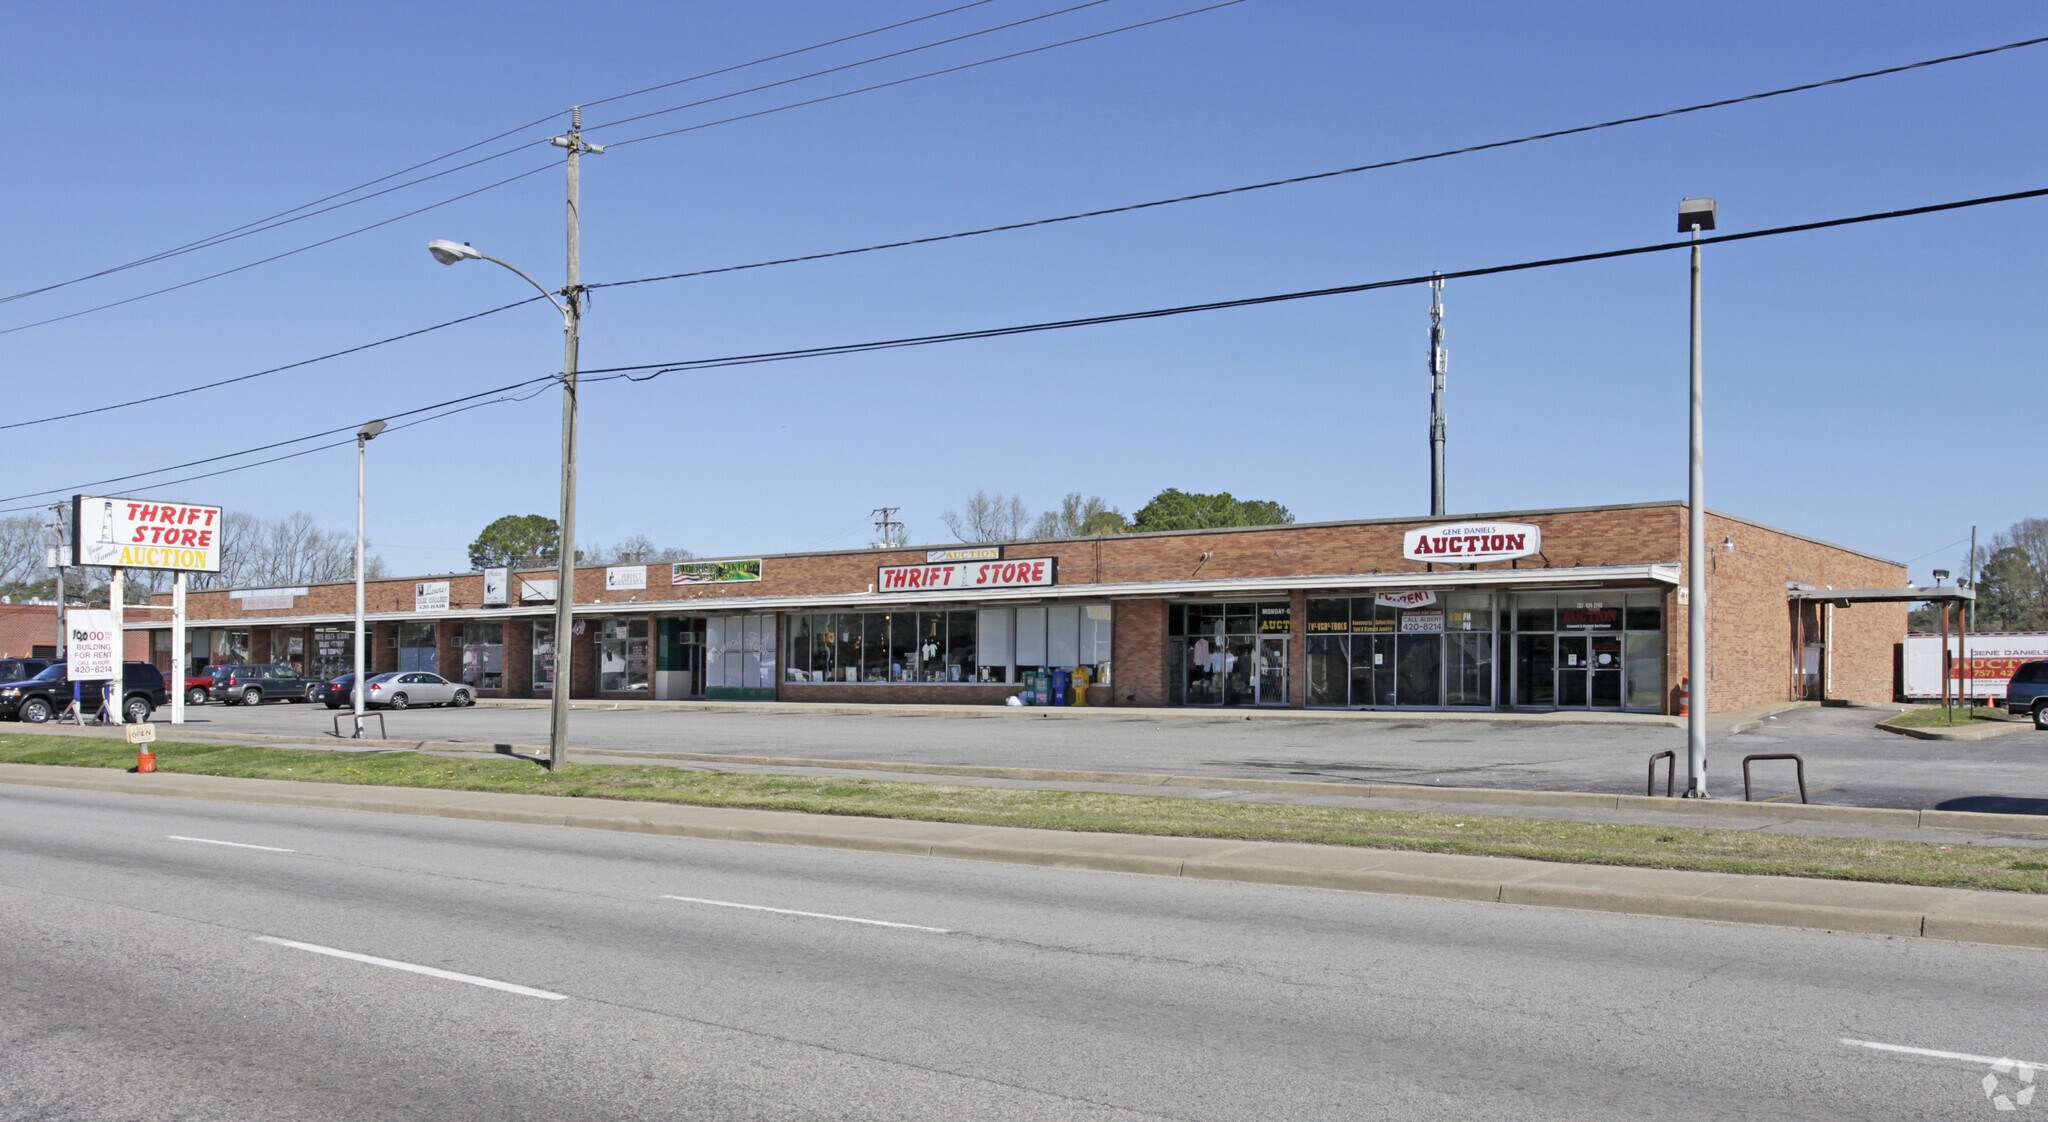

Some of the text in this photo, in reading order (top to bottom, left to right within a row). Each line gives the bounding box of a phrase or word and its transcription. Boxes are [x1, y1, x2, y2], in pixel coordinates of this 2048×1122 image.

[127, 503, 217, 526] THRIFT
[132, 526, 213, 547] STORE
[1414, 534, 1526, 554] AUCTION
[118, 546, 207, 568] AUCTION
[946, 549, 998, 559] AUCTION
[884, 562, 1045, 588] THRIFT STORE
[1261, 620, 1290, 630] AUCT
[1402, 623, 1442, 631] 420-8214
[76, 643, 111, 651] BUILDING
[93, 651, 112, 659] RENT
[74, 665, 112, 674] 420-8214
[131, 730, 152, 738] OPEN
